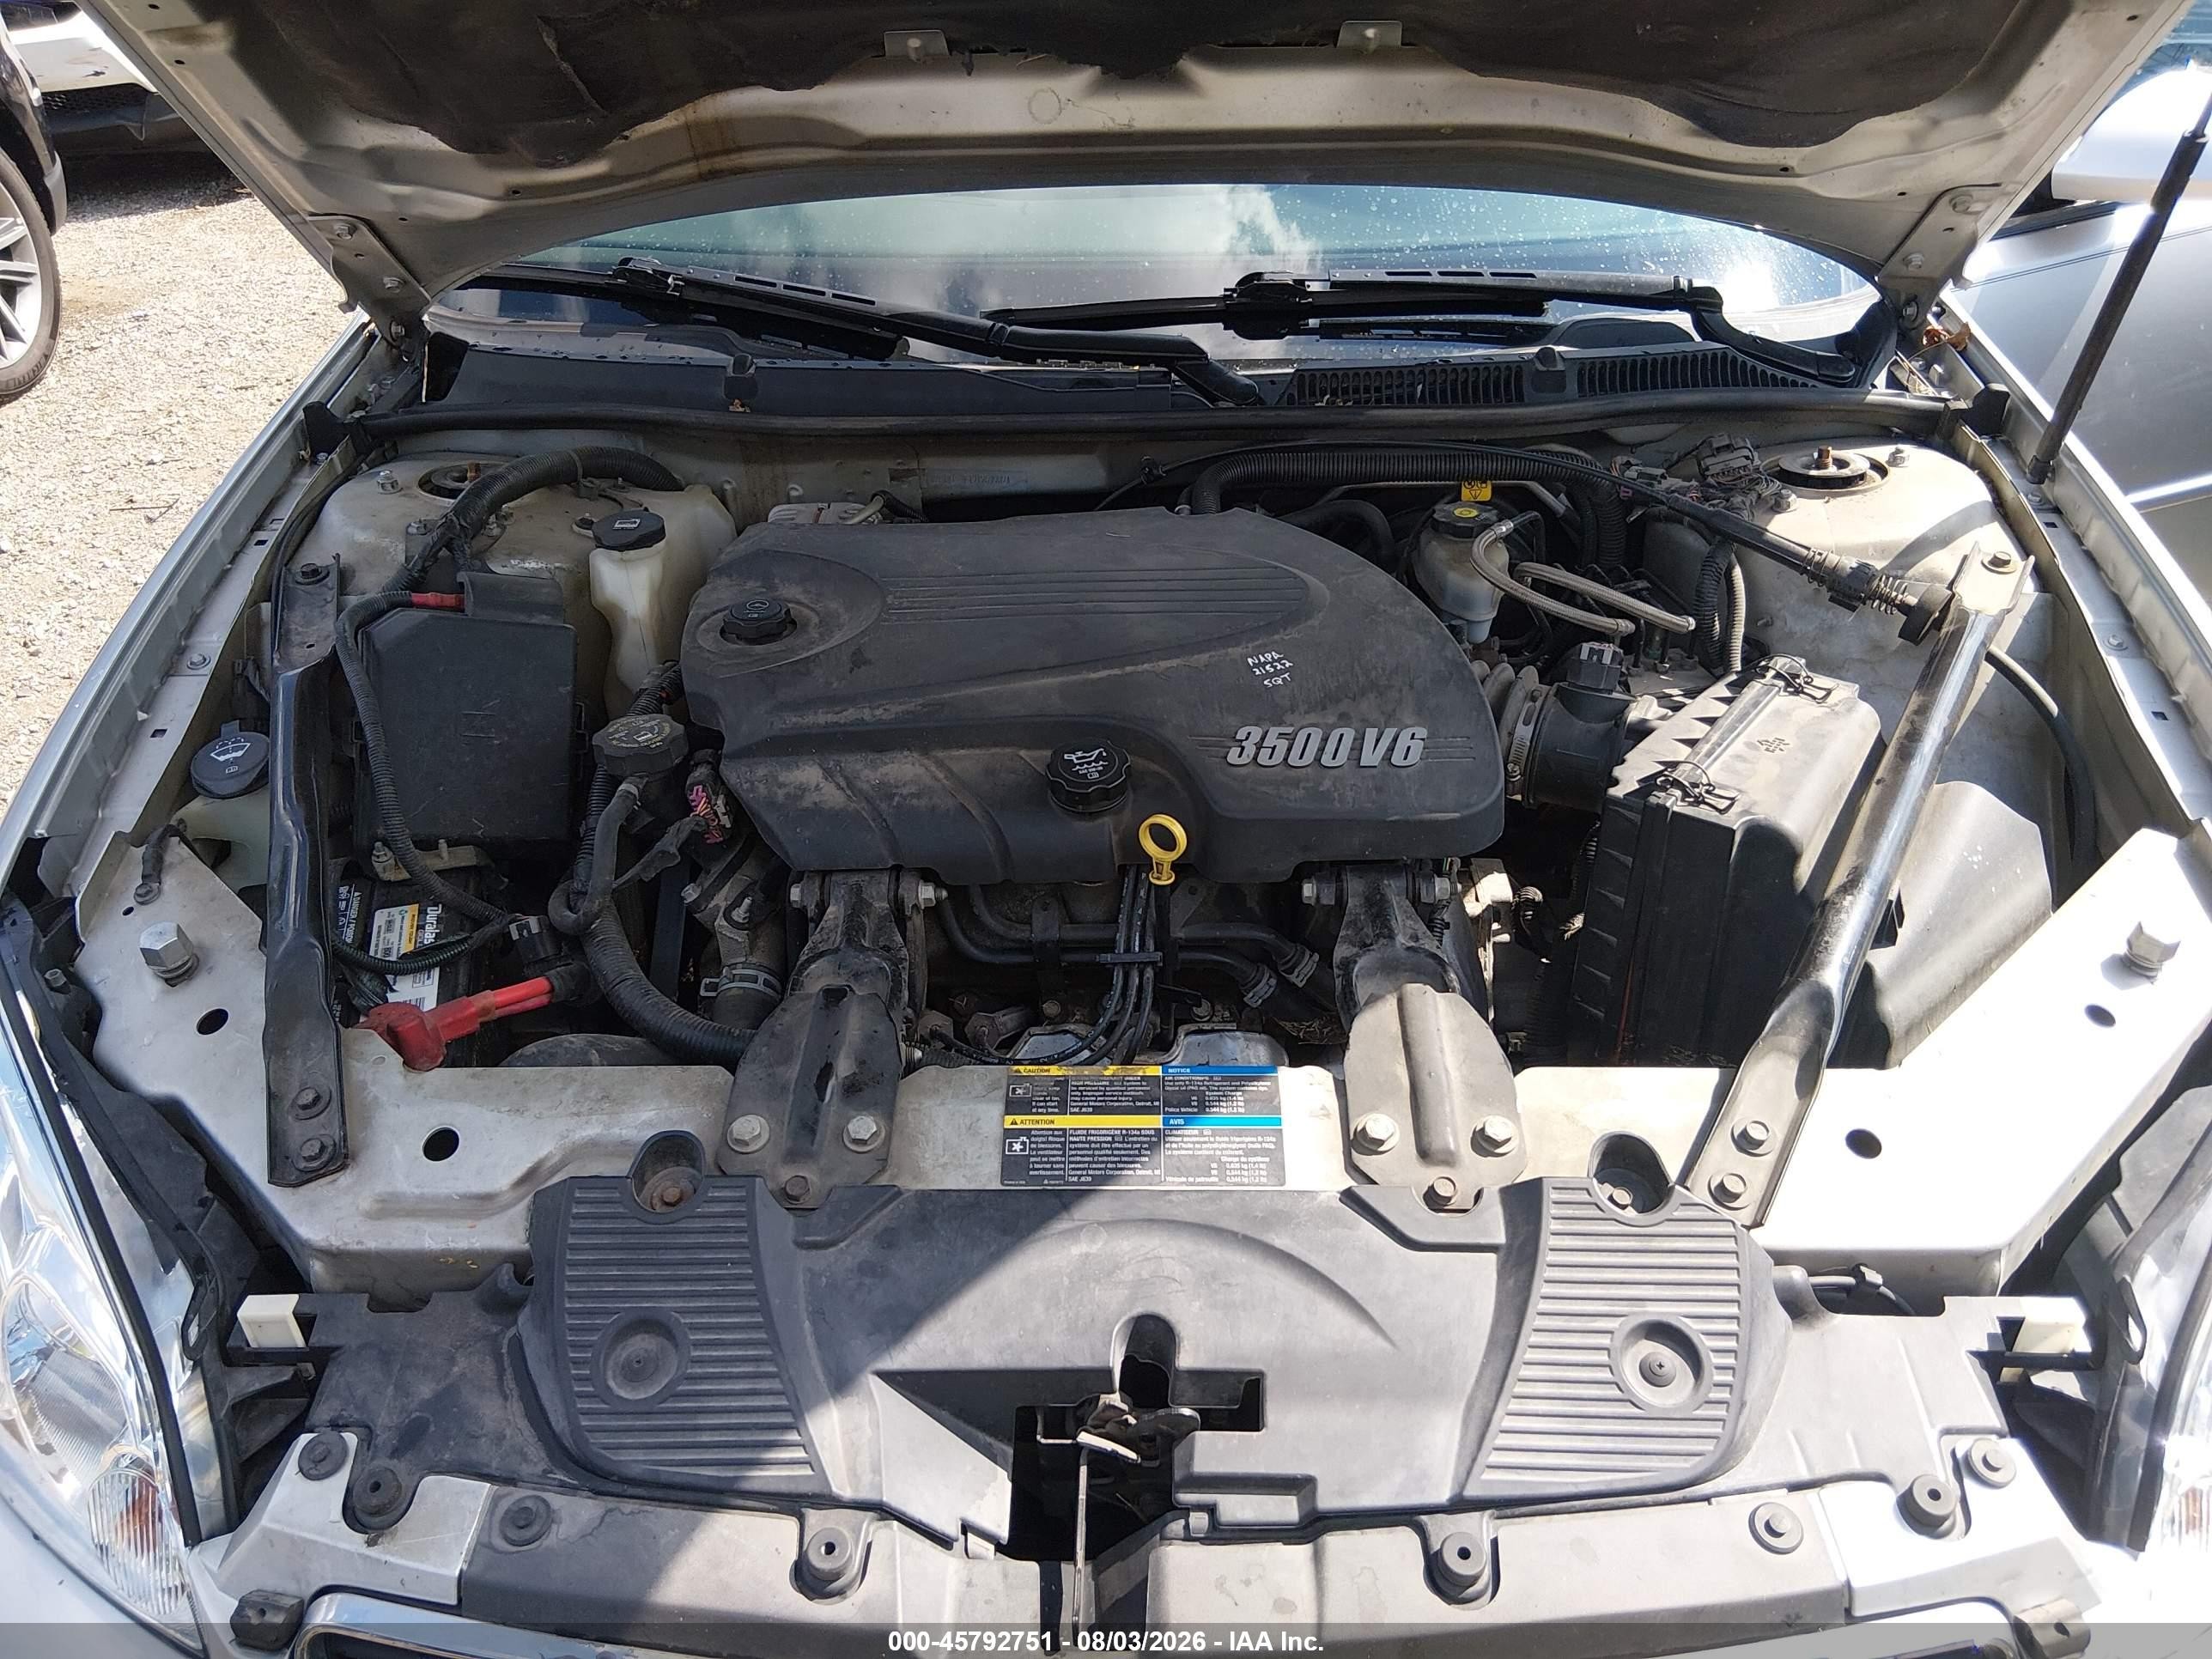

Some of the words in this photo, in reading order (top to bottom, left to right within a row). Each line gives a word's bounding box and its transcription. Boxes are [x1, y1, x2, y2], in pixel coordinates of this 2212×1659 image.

[1247, 651, 1284, 666] NAPA
[1252, 659, 1293, 676] 21522
[424, 903, 442, 945] Duralas
